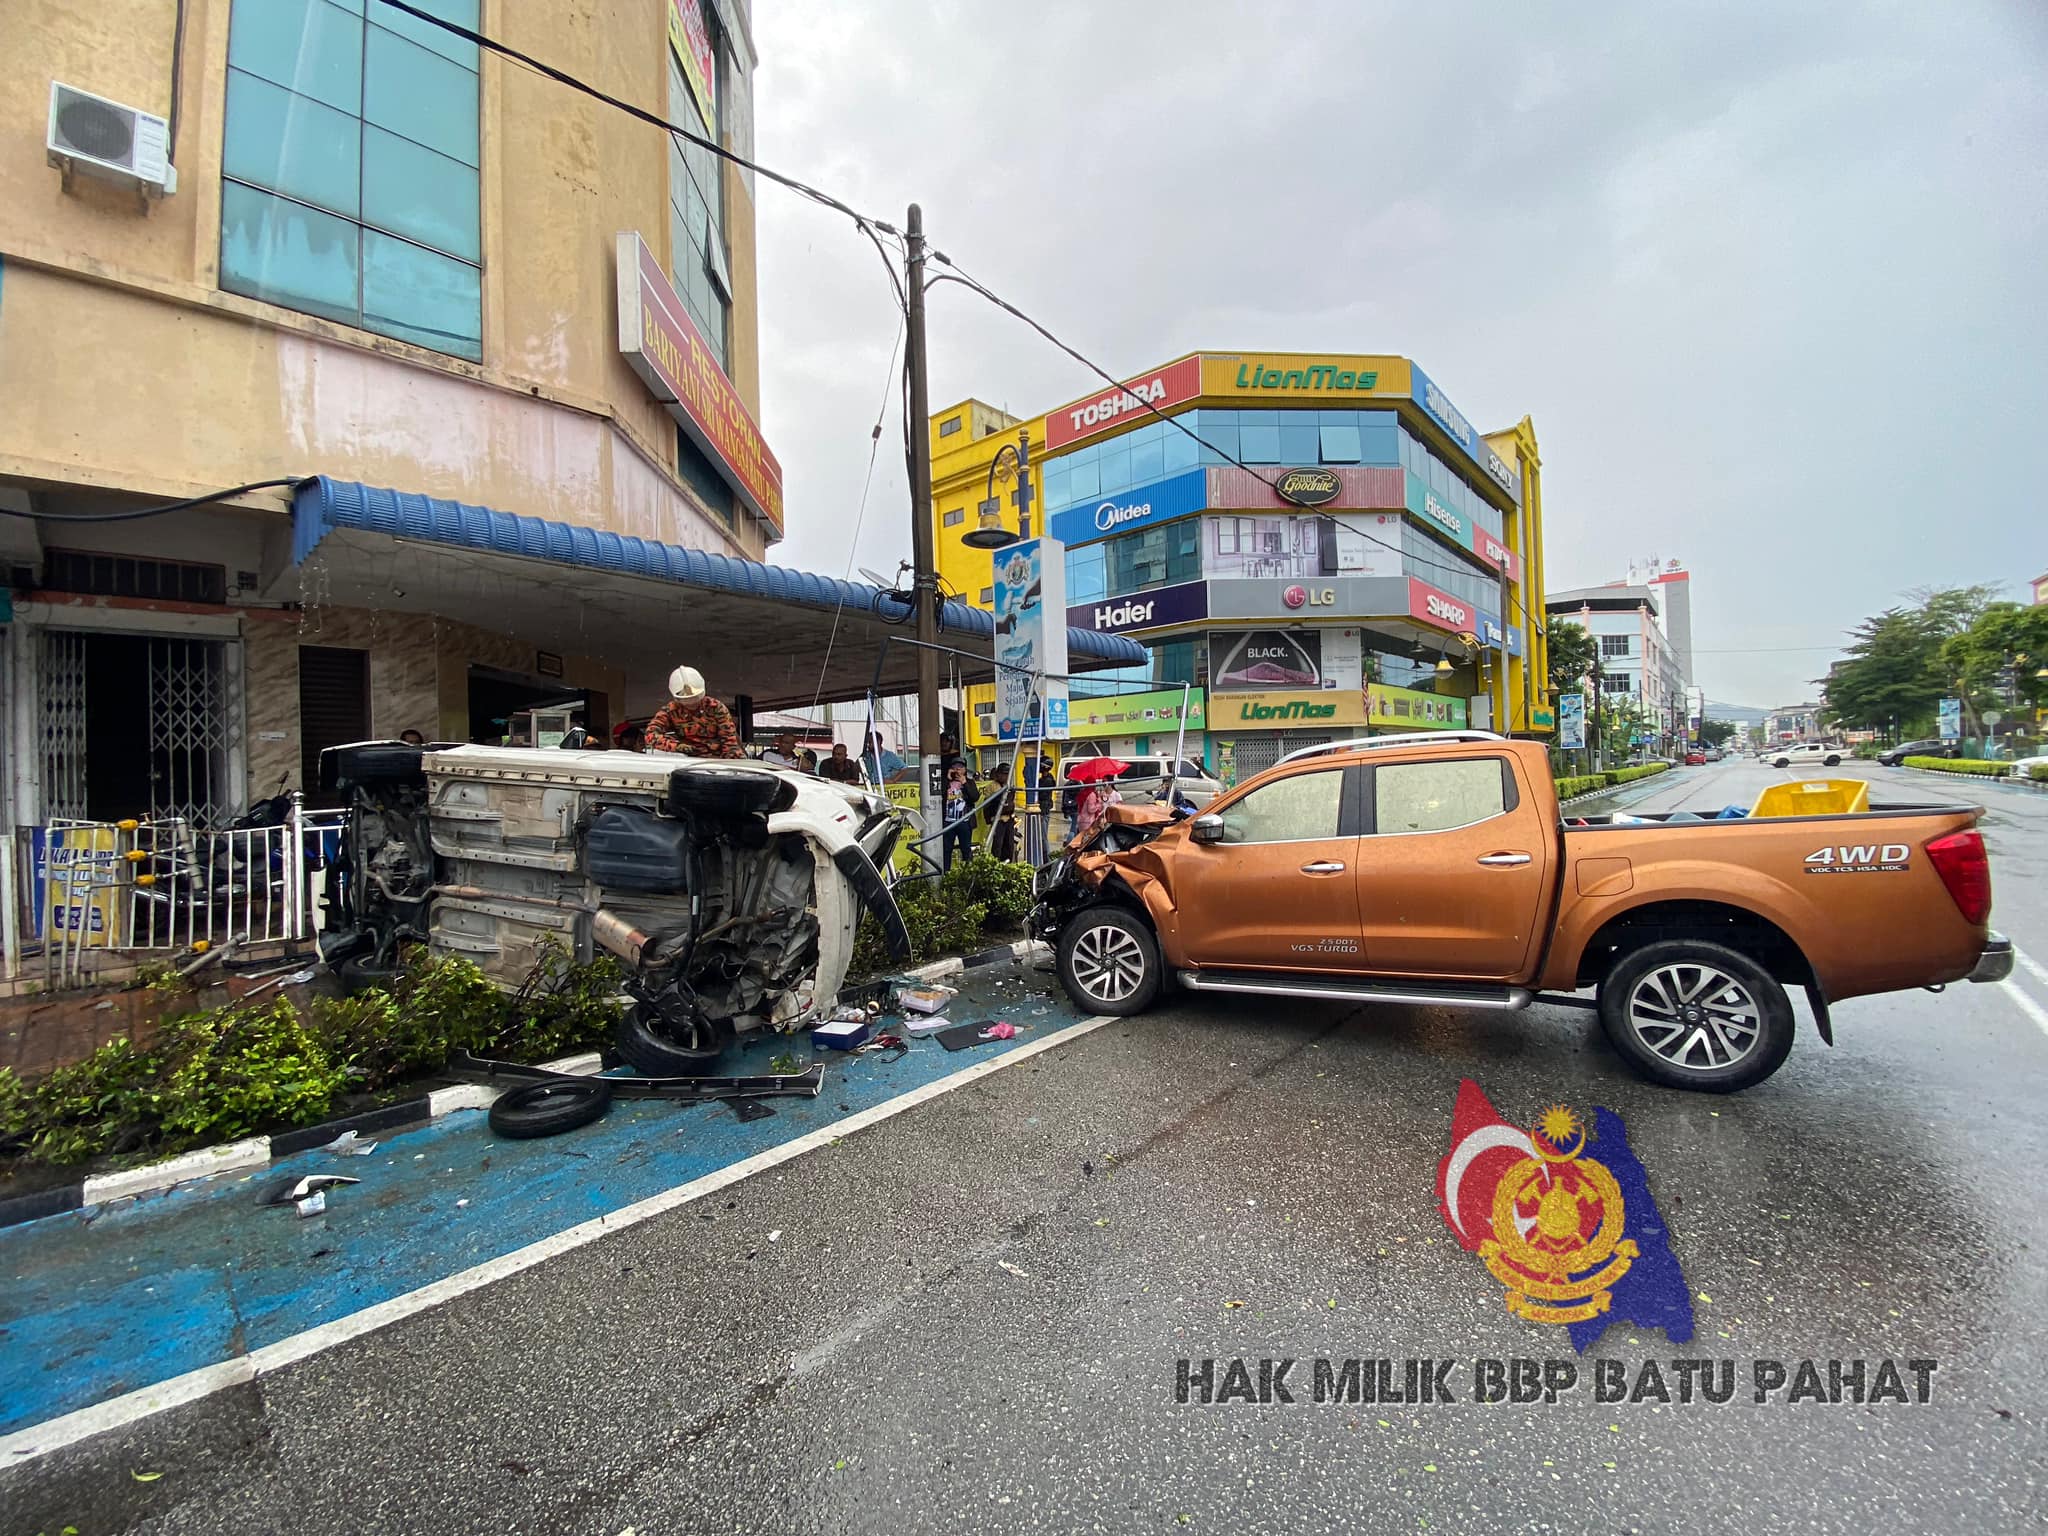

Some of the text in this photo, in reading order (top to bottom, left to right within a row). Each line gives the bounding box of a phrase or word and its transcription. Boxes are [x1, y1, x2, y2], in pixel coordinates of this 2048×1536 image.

[1236, 363, 1379, 390] LionMas
[644, 304, 700, 411] BARIYANI
[702, 387, 715, 433] SRI
[715, 414, 750, 480] WANGSA
[690, 336, 761, 465] RESTORAN
[1071, 378, 1167, 431] TOSHIBA
[1425, 383, 1470, 446] SAMSUNG
[1284, 473, 1335, 495] Goodnite
[1488, 454, 1513, 490] SONY
[1096, 503, 1151, 531] Midea
[1424, 492, 1461, 534] Hisense
[1310, 588, 1335, 605] LG
[1427, 594, 1465, 626] SHARP
[1095, 600, 1155, 630] Haier
[1240, 701, 1337, 721] LionMas
[1804, 844, 1910, 865] 4WD
[1290, 944, 1358, 953] VGS TURBO
